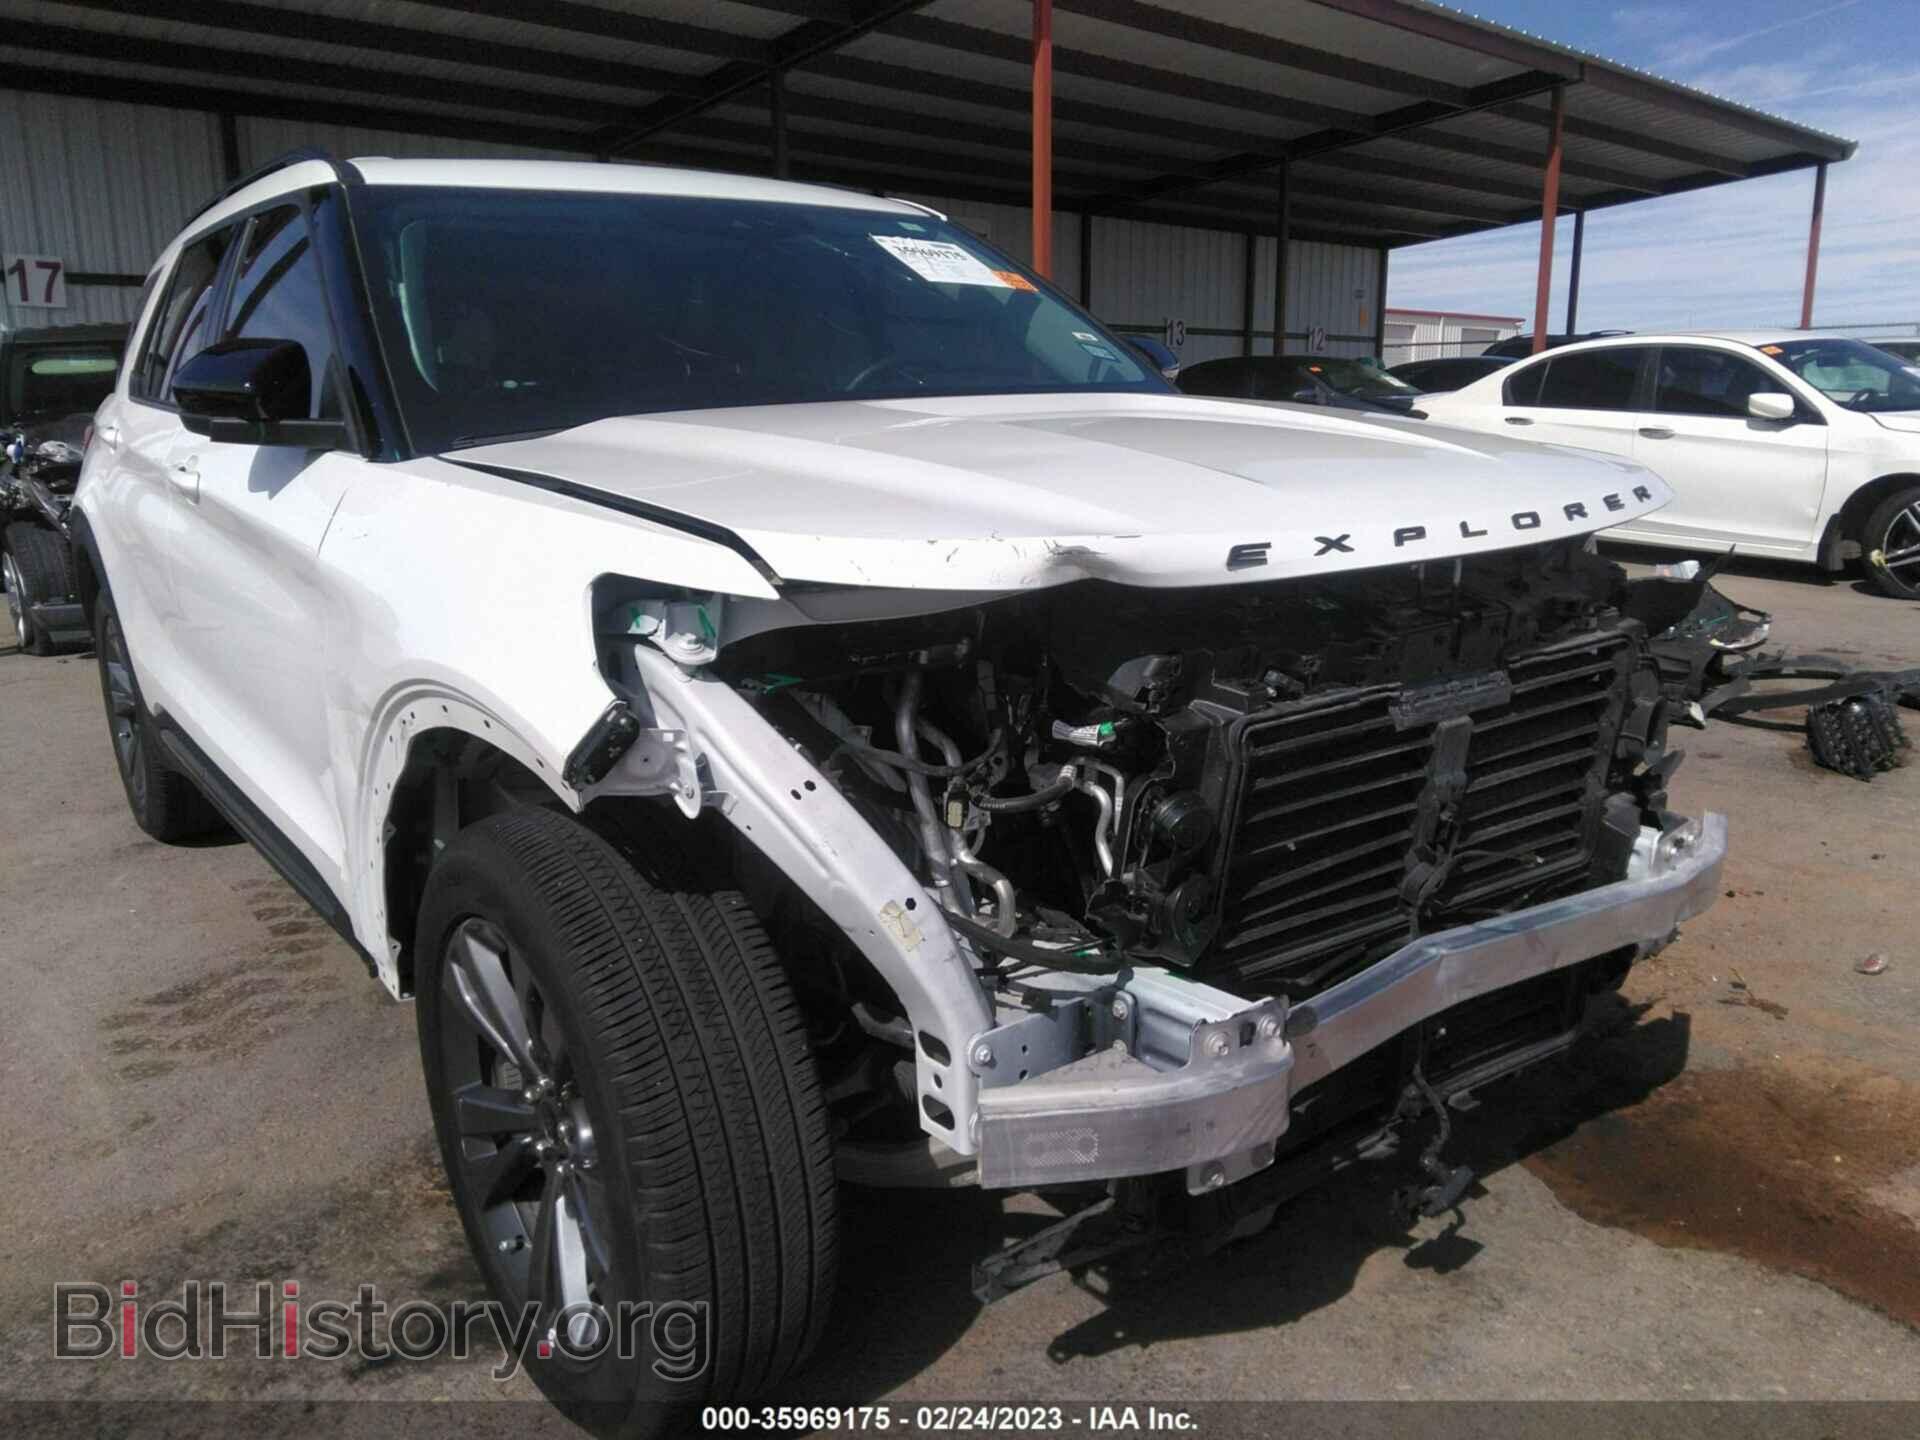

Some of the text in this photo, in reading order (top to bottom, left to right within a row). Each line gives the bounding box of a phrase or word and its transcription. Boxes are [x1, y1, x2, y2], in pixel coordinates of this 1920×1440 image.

[8, 259, 61, 303] 17
[1167, 320, 1185, 346] 13
[1310, 327, 1325, 351] 12
[1226, 485, 1652, 572] EXPLORER
